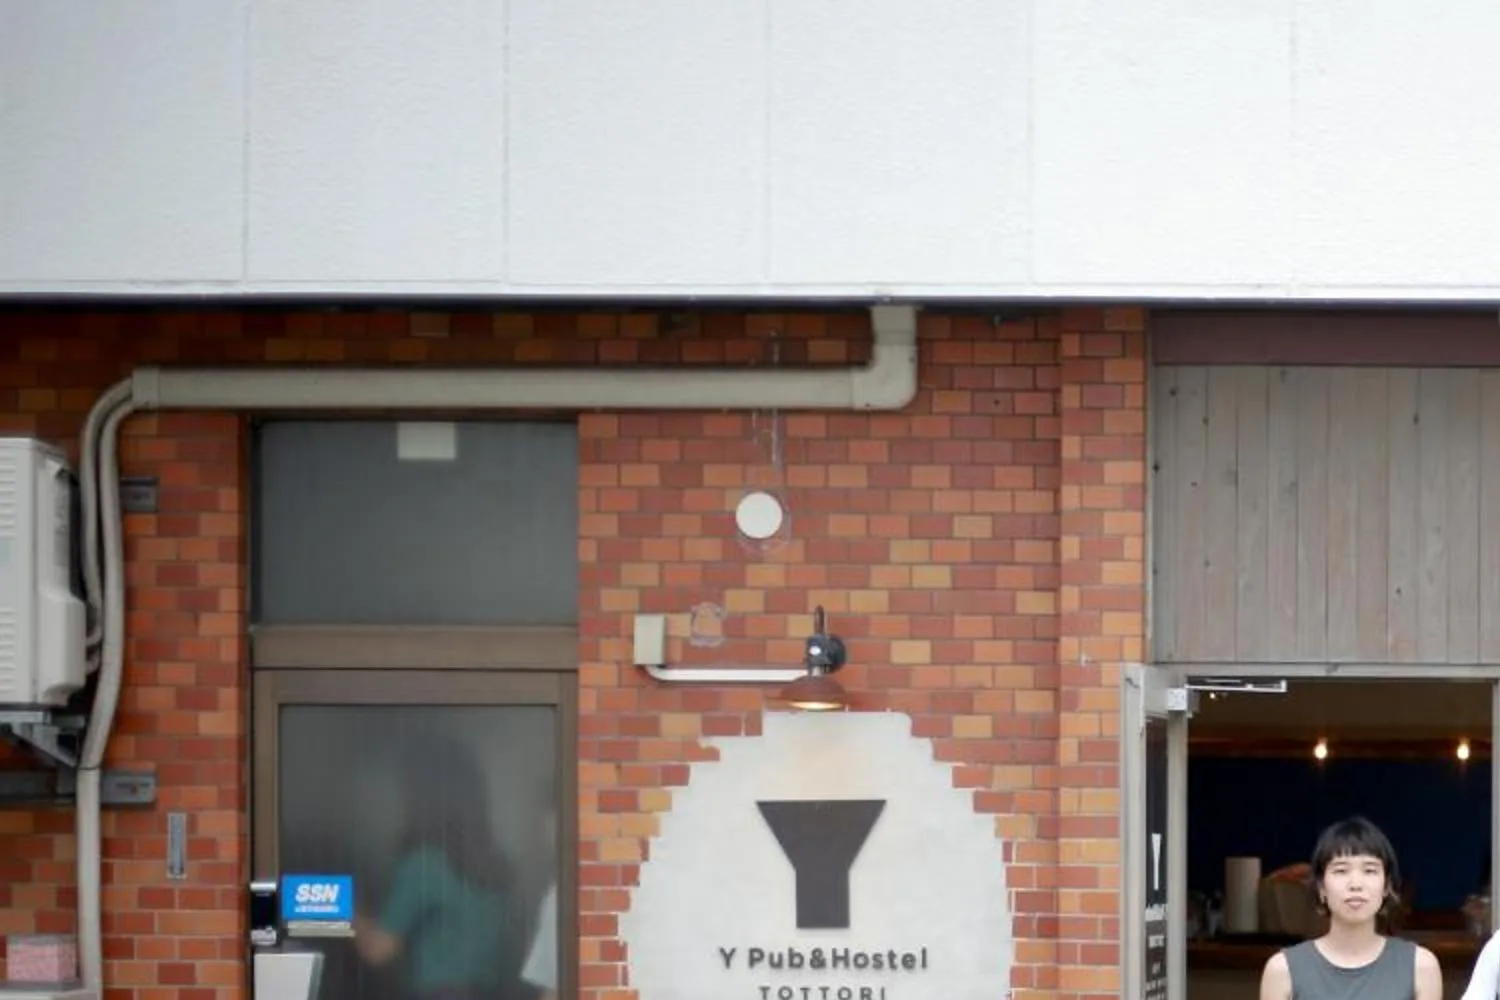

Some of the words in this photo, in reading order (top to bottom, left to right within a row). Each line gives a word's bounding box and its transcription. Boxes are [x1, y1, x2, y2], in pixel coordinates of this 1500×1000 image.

[755, 798, 887, 930] Y
[295, 883, 340, 903] SSN
[719, 947, 737, 970] Y
[749, 946, 928, 970] Pub&Hostel
